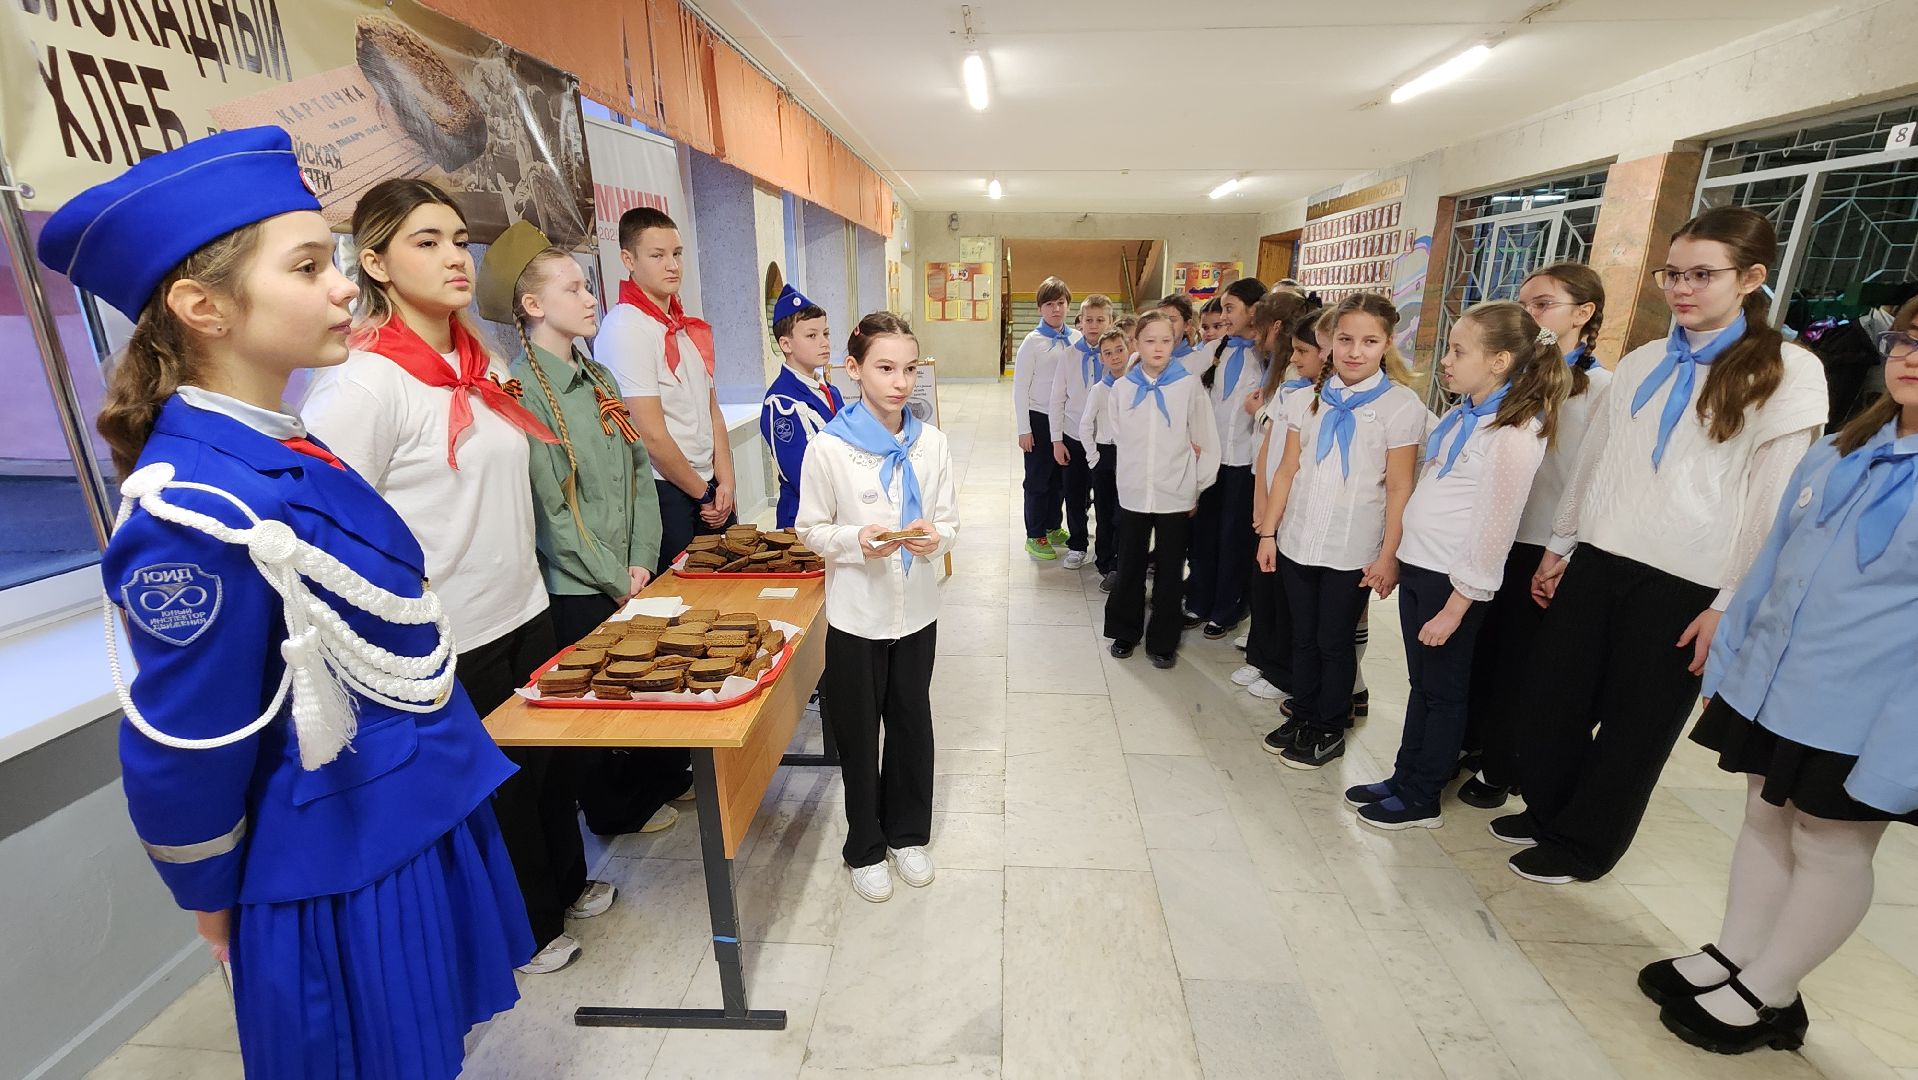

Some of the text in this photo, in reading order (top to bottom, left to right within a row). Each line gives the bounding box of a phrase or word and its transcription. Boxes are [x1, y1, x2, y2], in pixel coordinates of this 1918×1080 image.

[20, 0, 292, 83] АДНЫЙ
[31, 41, 189, 167] ХЛЕБ
[276, 85, 367, 124] КАРТОЧКА
[1895, 127, 1909, 142] 8
[598, 226, 618, 242] 202
[143, 568, 193, 584] ЮИД
[151, 612, 206, 625] ИНСПЕКТОР
